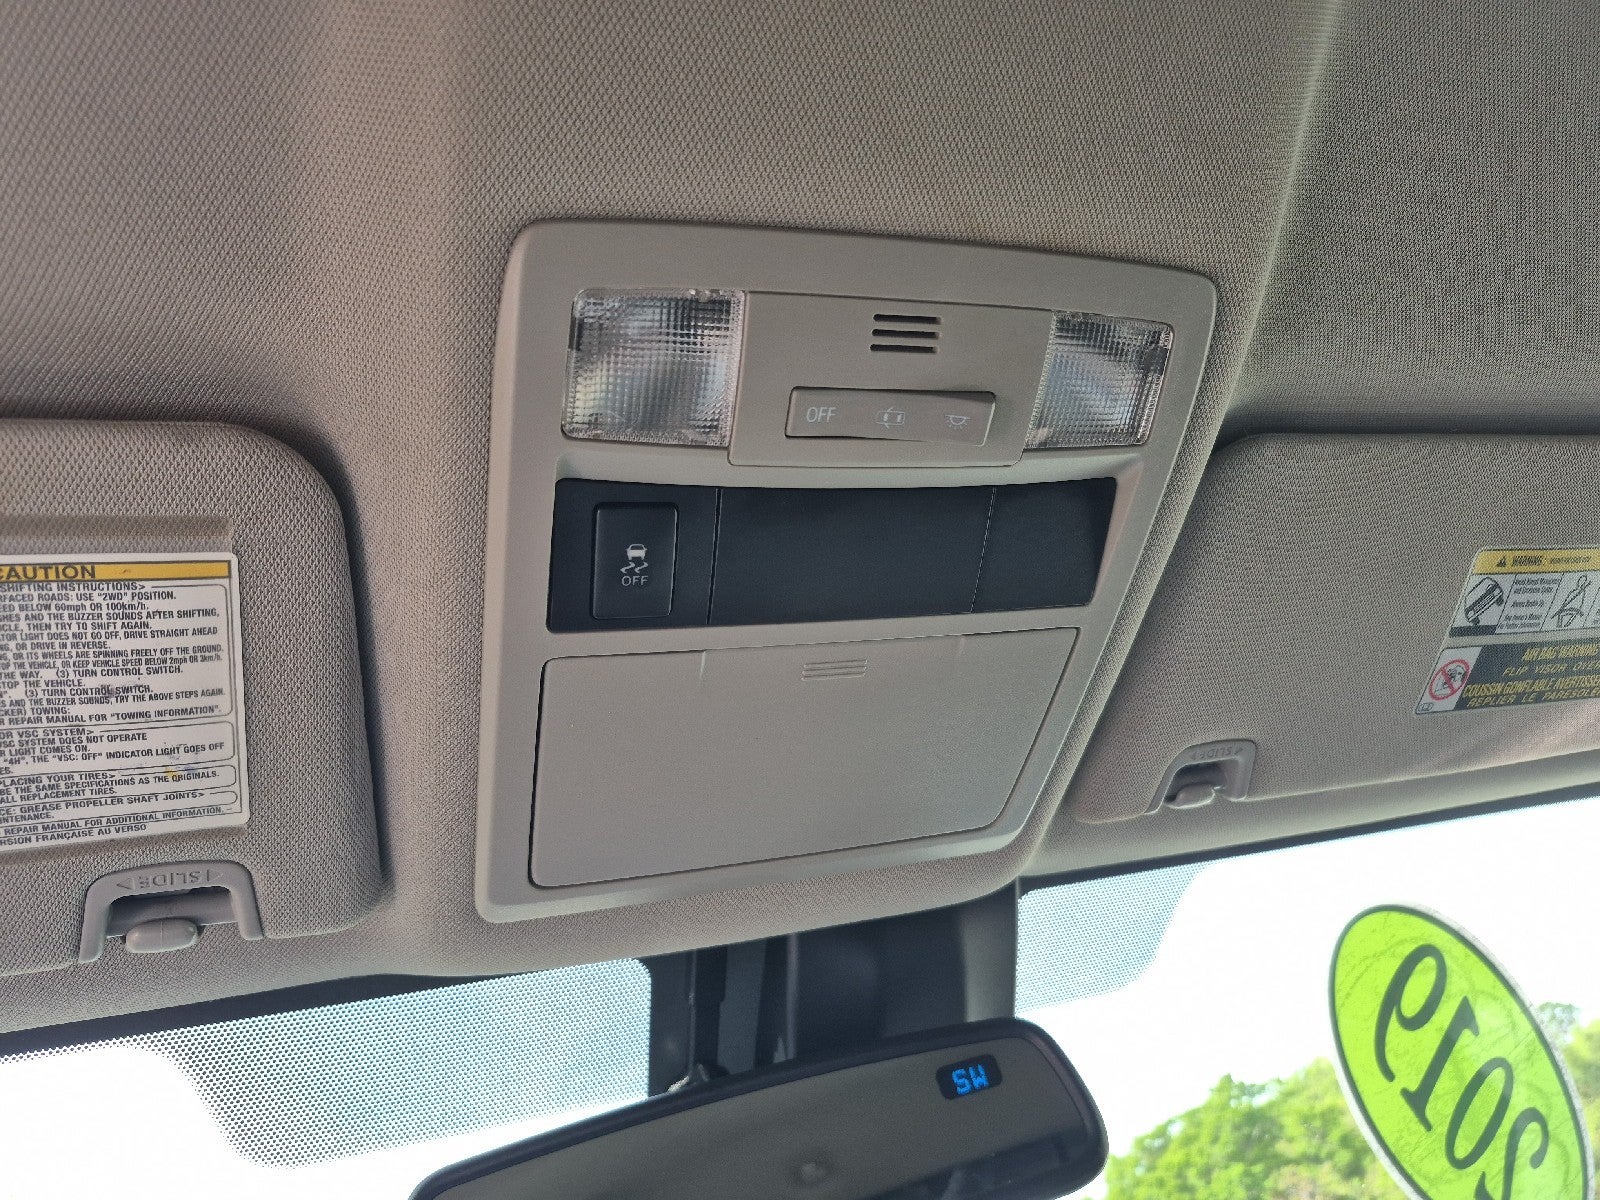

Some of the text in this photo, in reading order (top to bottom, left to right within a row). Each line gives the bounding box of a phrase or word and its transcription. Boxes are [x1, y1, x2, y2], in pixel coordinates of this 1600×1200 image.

[806, 406, 837, 423] OFF
[0, 565, 95, 580] AUTION
[621, 575, 649, 586] OFF
[38, 591, 176, 602] ROADS: USE "2WD" POSITION.
[19, 601, 149, 612] BELOW 60mph OR 100km/h.
[25, 612, 44, 622] AND
[48, 612, 63, 621] THE
[68, 612, 103, 621] BUZZER
[106, 611, 143, 621] SOUNDS
[146, 610, 174, 620] AFTER
[177, 608, 220, 619] SHIFTING,
[27, 622, 52, 631] THEN
[56, 622, 73, 631] TRY
[77, 622, 88, 631] TO
[91, 621, 117, 630] SHIFT
[121, 620, 152, 630] AGAIN.
[0, 626, 218, 641] TOR LIGHT DOES NOT GO OFF, DRIVE STRAIGHT AHEAD
[13, 644, 224, 660] OR ITS WHEELS ARE SPINNING FREELY OFF THE GROUND.
[16, 642, 27, 650] OR
[31, 641, 56, 650] DRIVE
[59, 641, 67, 649] IN
[71, 641, 110, 649] REVERSE.
[14, 653, 223, 670] THE VEHICLE, OR KEEP VEHICLE SPEED BELOW 2mph OR 3km/h.
[20, 671, 43, 679] WAY.
[56, 669, 70, 679] (3)
[74, 669, 98, 678] TURN
[101, 667, 143, 677] CONTROL
[146, 665, 183, 676] SWITCH.
[1503, 666, 1529, 677] FLIP
[0, 679, 86, 689] TOP THE VEHICLE.
[25, 684, 154, 699] (3) TURN CONTROL SWITCH.
[9, 688, 225, 707] AND THE BUZZER SOUNDS, TRY THE ABOVE STEPS AGAIN.
[1522, 694, 1537, 704] LE
[9, 715, 43, 726] REPAIR
[45, 714, 87, 724] MANUAL
[88, 713, 108, 722] FOR
[111, 711, 152, 721] "TOWING
[154, 705, 221, 718] INFORMATION".
[31, 706, 71, 716] TOWING:
[17, 729, 39, 739] VSC
[18, 732, 148, 748] SYSTEM DOES NOT OPERATE
[9, 747, 36, 757] LIGHT
[39, 745, 72, 755] COMES
[75, 744, 91, 753] ON.
[31, 754, 50, 764] THE
[106, 749, 153, 760] INDICATOR
[155, 746, 181, 756] LIGHT
[183, 745, 206, 754] GOES
[208, 742, 225, 751] OFF
[15, 785, 32, 795] THE
[36, 783, 62, 792] SAME
[65, 776, 136, 790] SPECIFICATIONS
[138, 776, 150, 785] AS
[153, 775, 169, 783] THE
[171, 770, 220, 782] ORIGINALS.
[46, 774, 75, 784] YOUR
[20, 788, 86, 802] REPLACEMENT
[89, 786, 118, 796] TIRES.
[20, 802, 63, 814] GREASE
[65, 797, 124, 810] PROPELLER
[127, 794, 160, 805] SHAFT
[4, 806, 225, 836] REPAIR MANUAL FOR ADDITIONAL INFORMATION.
[35, 829, 95, 843] FRANÇAISE
[97, 827, 112, 836] AU
[114, 823, 147, 835] VERSO
[139, 871, 200, 889] SLIDE
[952, 1063, 990, 1096] SW
